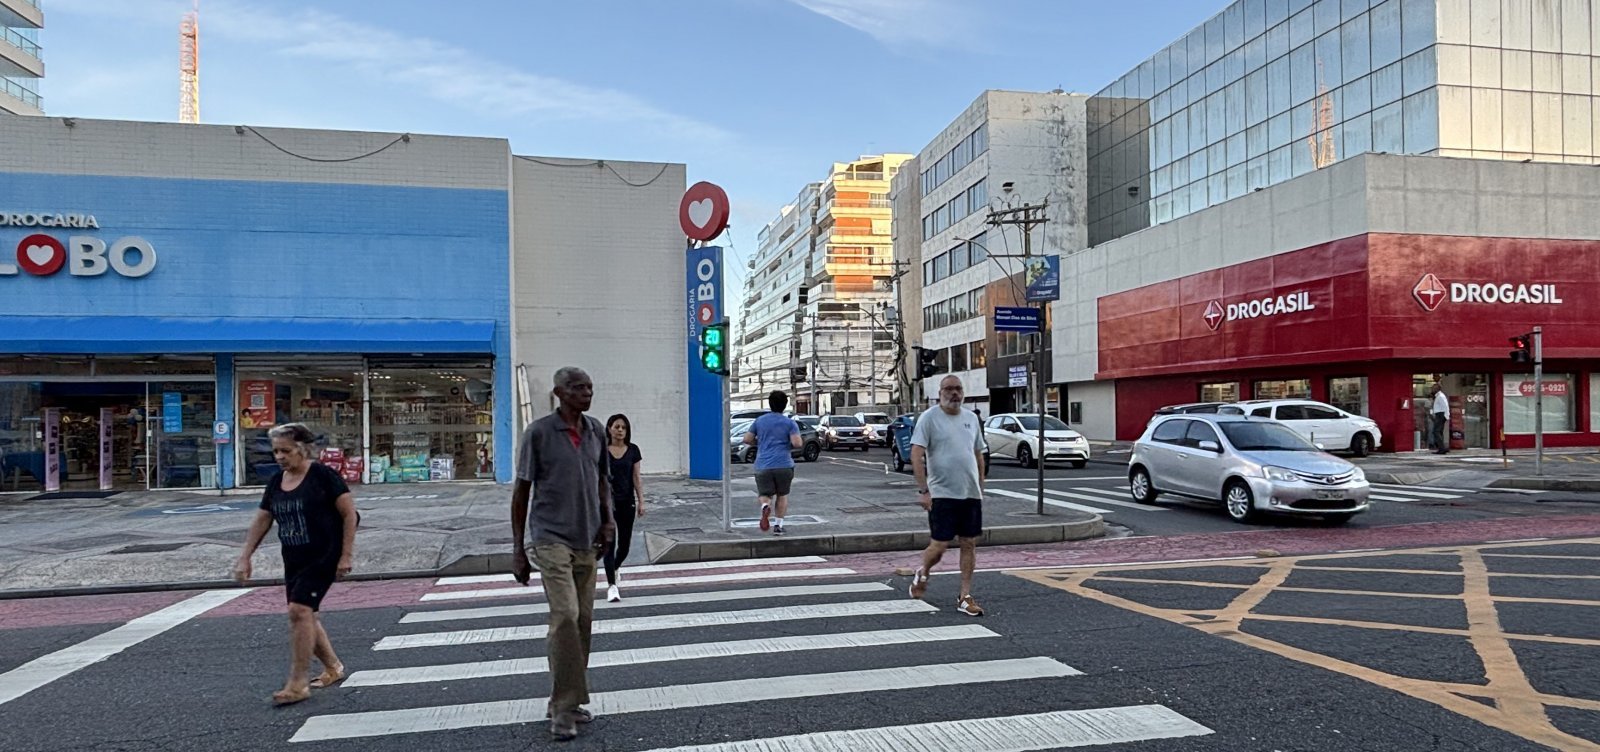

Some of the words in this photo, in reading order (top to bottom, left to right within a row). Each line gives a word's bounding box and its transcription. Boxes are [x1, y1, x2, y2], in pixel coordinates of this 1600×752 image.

[1451, 283, 1562, 304] DROGASIL
[1226, 292, 1315, 321] DROGASIL
[218, 424, 224, 432] E
